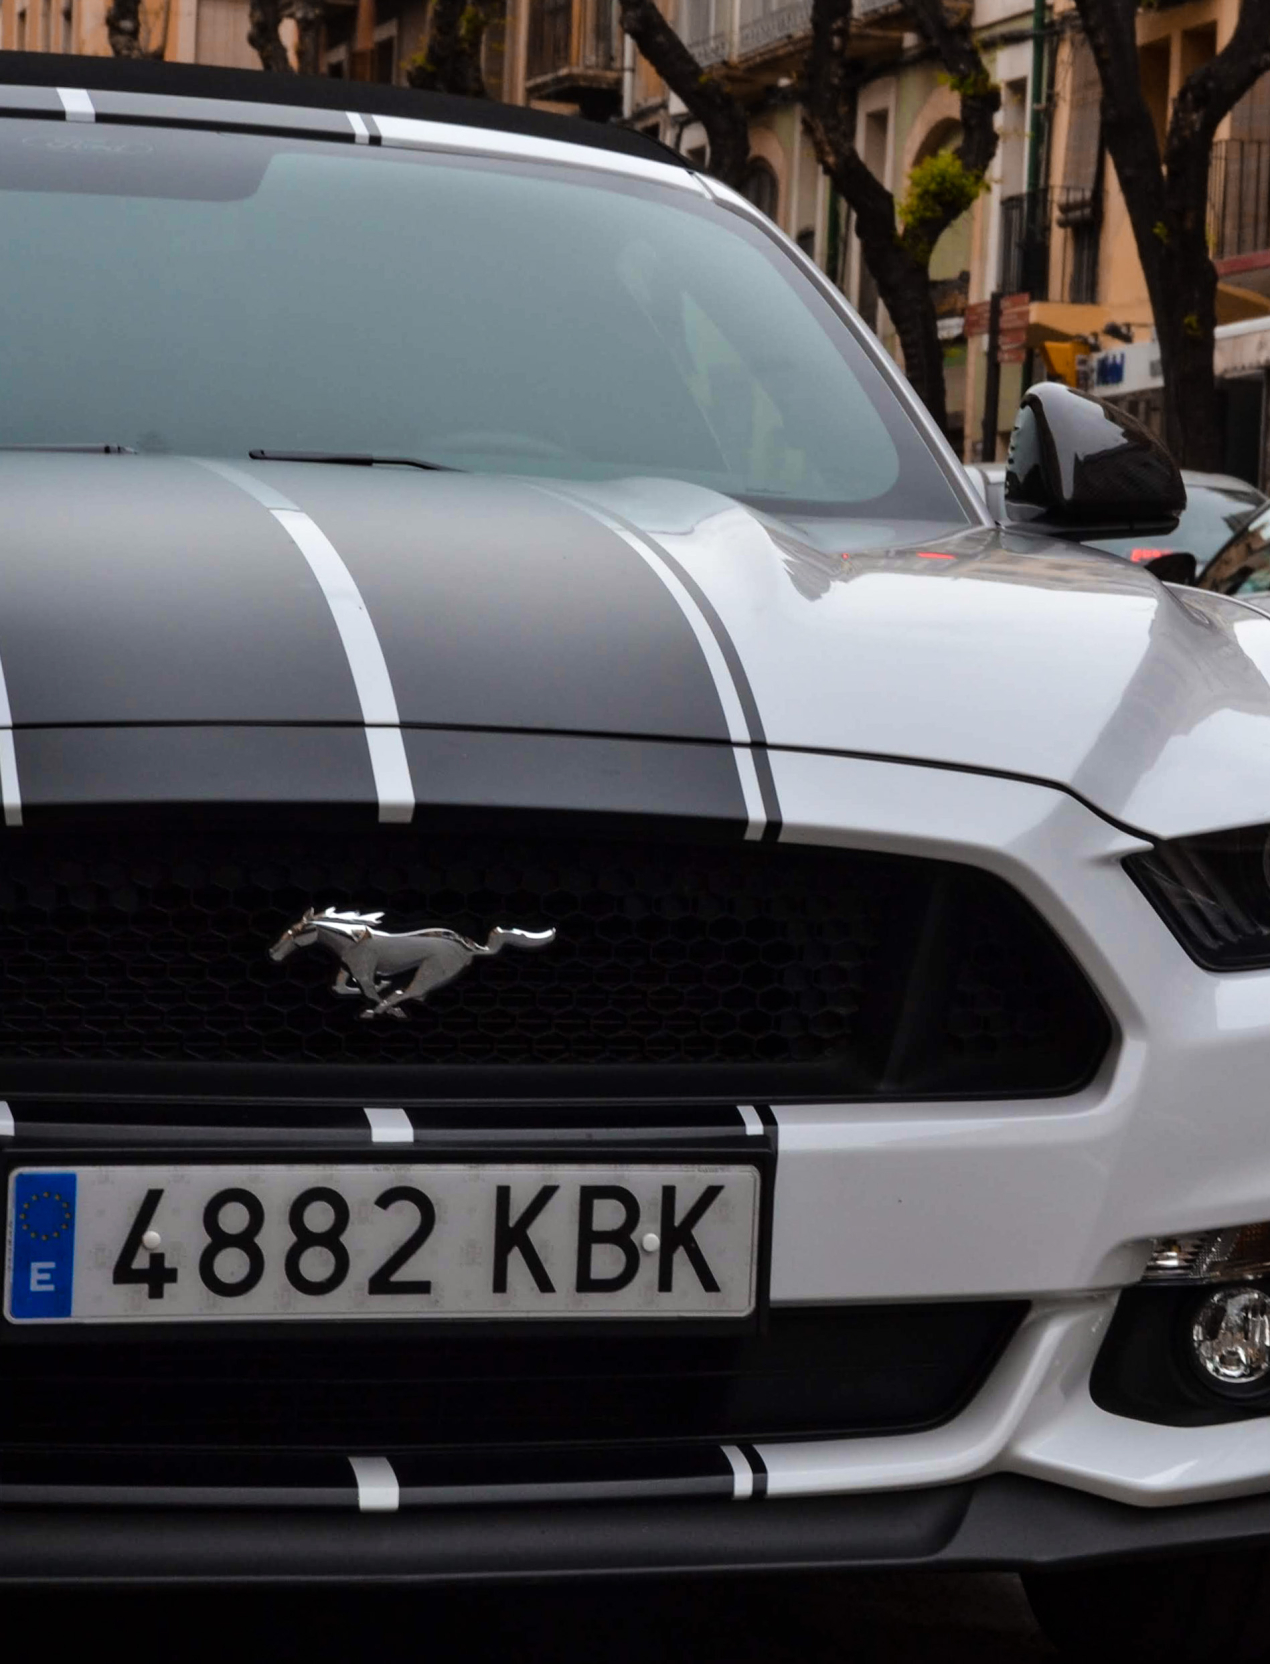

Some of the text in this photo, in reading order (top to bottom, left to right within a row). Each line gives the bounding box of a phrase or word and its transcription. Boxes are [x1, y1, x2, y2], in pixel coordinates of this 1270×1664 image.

[29, 1261, 56, 1293] E
[112, 1185, 436, 1300] 4882
[492, 1184, 726, 1294] KBK
